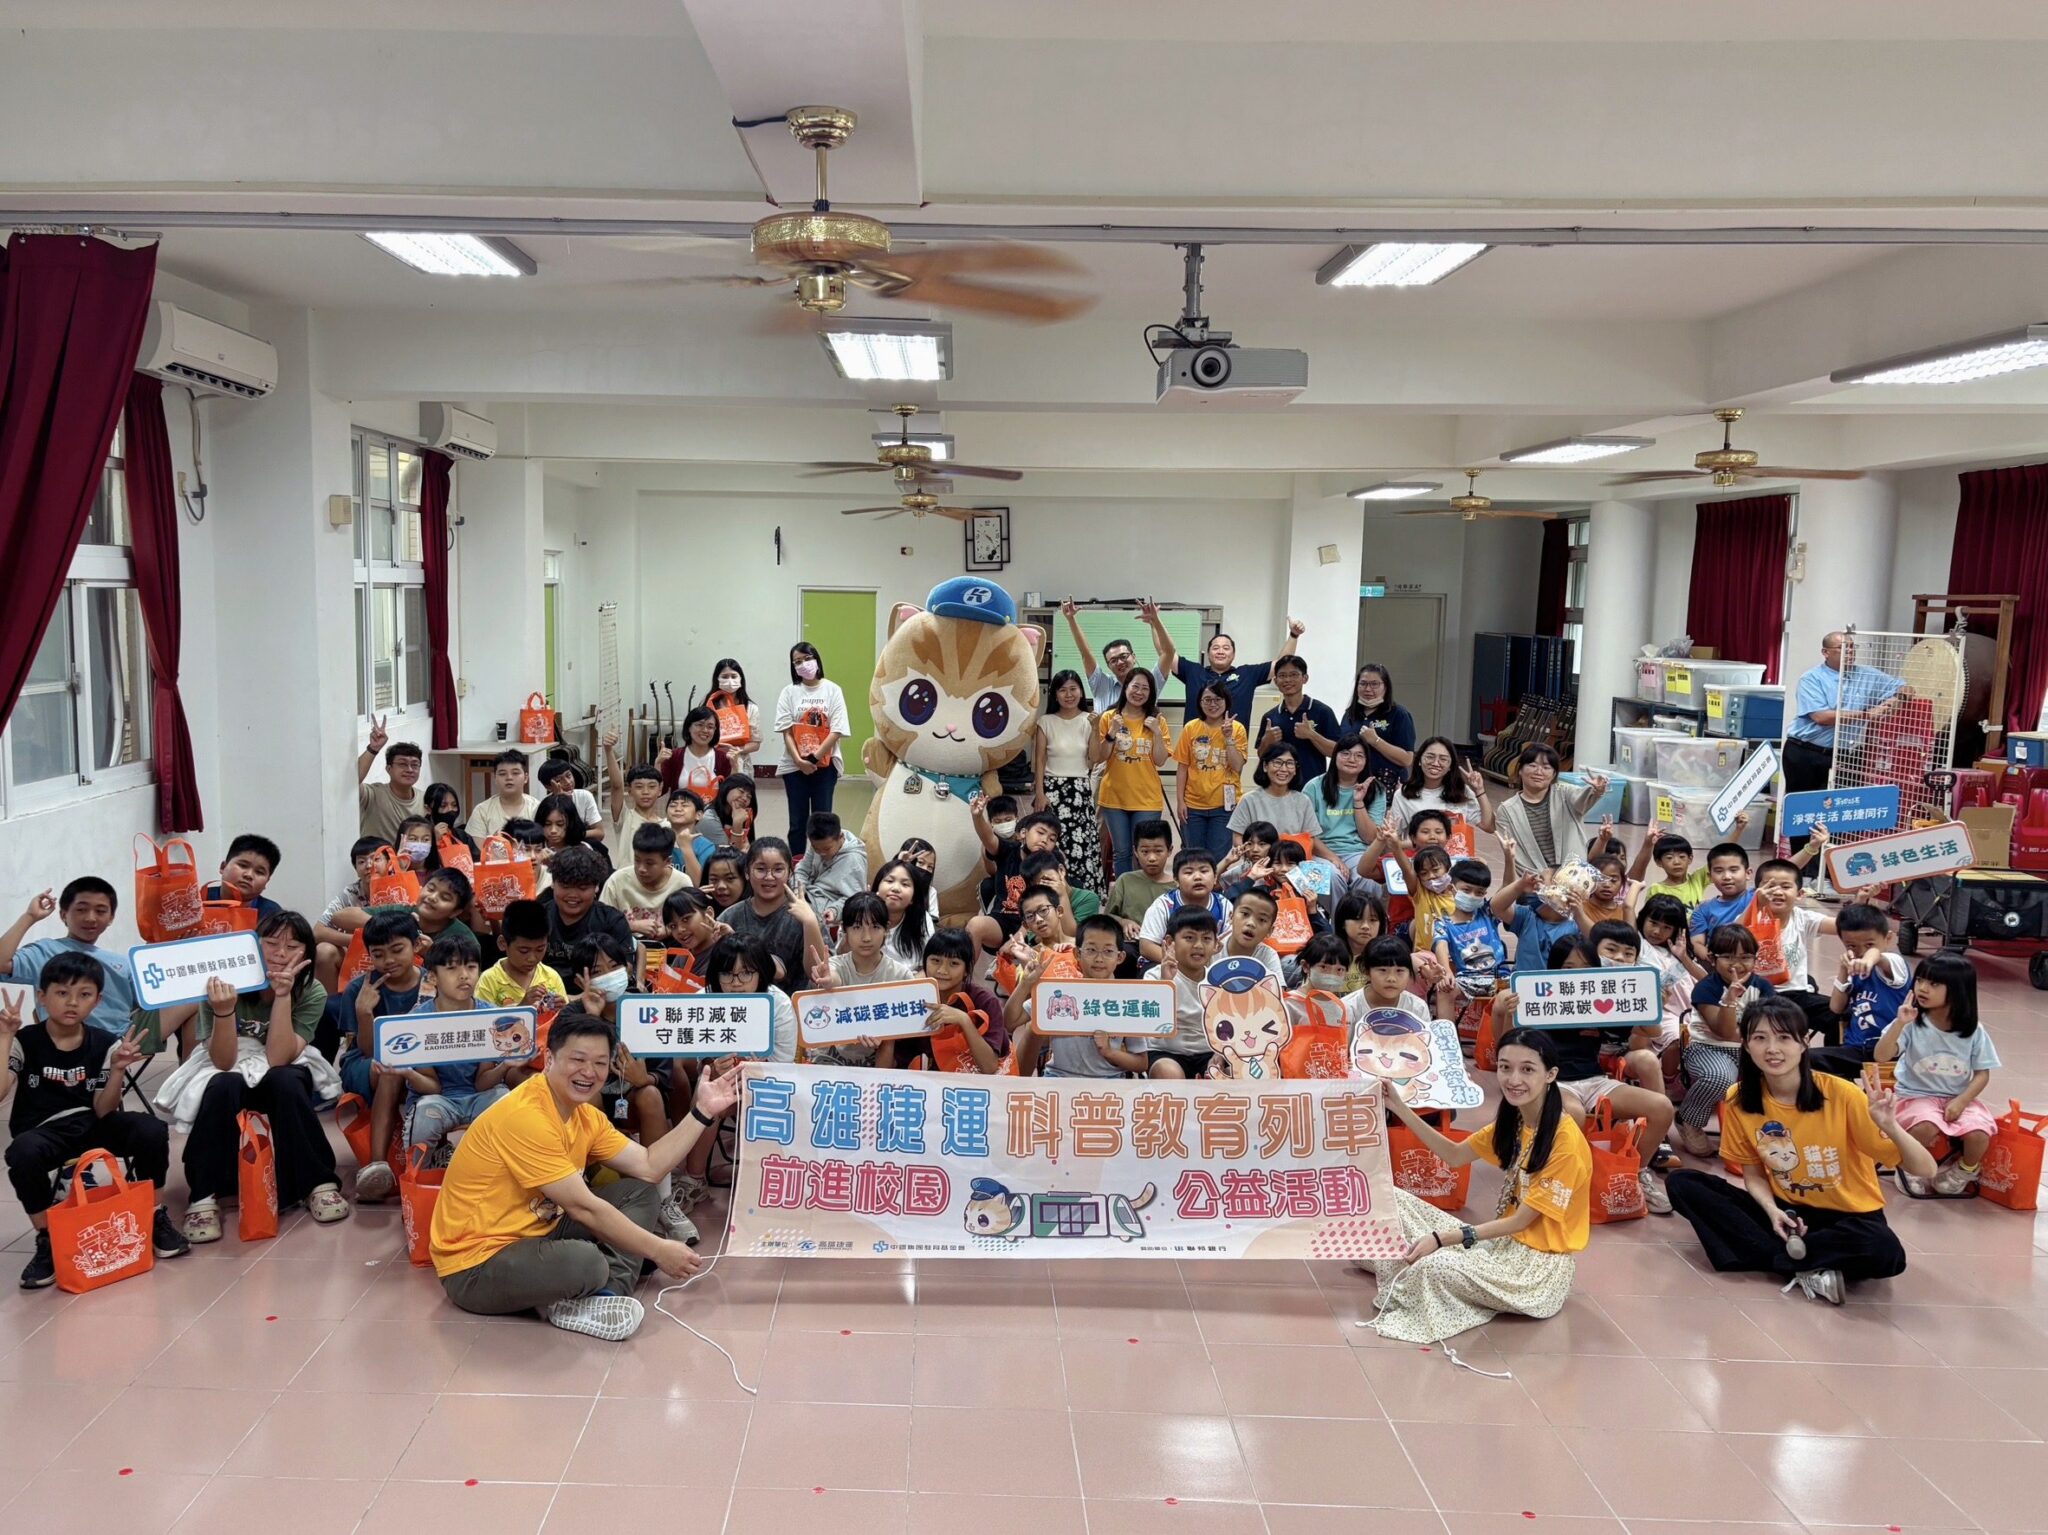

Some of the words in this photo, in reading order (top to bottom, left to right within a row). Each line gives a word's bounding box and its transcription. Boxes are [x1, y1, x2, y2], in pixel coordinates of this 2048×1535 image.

[1792, 810, 1839, 825] 淨零生活
[1841, 806, 1889, 822] 高捷同行
[1880, 839, 1959, 868] 綠色生活
[165, 953, 257, 978] 中鋼集團教育基金會
[1559, 978, 1637, 996] 聯邦銀行
[665, 1006, 747, 1024] 聯邦減碳
[835, 999, 928, 1024] 減碳愛地球
[1082, 999, 1161, 1018] 綠色運輸
[1525, 1000, 1592, 1016] 陪你減碳
[1615, 998, 1649, 1013] 地球
[424, 1029, 486, 1045] 高雄捷運
[655, 1027, 737, 1045] 守護未來
[1006, 1091, 1381, 1160] 科普教育列車
[758, 1154, 951, 1216] 前進校園
[1173, 1165, 1372, 1220] 公益活動
